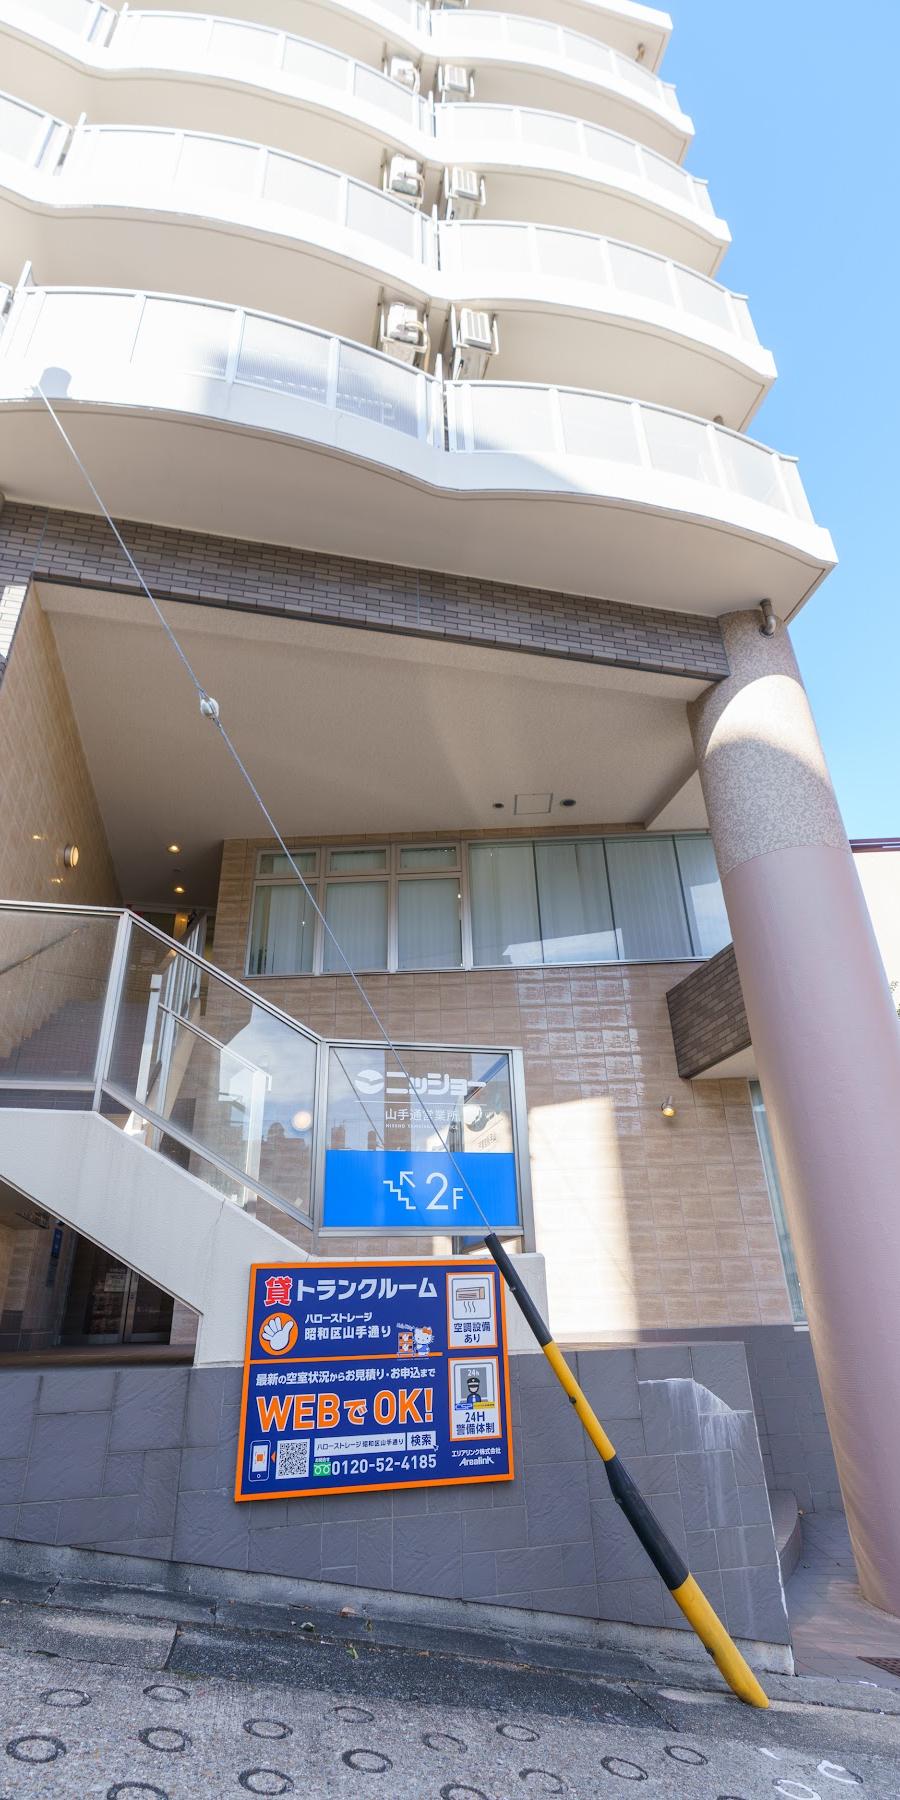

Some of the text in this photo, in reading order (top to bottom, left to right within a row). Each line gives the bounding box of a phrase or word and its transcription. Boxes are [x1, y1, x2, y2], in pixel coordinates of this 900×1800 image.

[386, 1071, 487, 1096] ニッショー
[425, 1172, 464, 1210] 2F
[305, 1312, 372, 1324] ハローストレージ
[304, 1325, 391, 1341] 昭和区山手通り
[453, 1321, 491, 1333] 空調設備
[464, 1333, 480, 1344] あり
[465, 1411, 485, 1423] 24H
[456, 1422, 495, 1436] 警備体制
[410, 1433, 432, 1447] 検索
[331, 1454, 437, 1476] 0120-52-4185
[458, 1456, 495, 1467] Arealink
